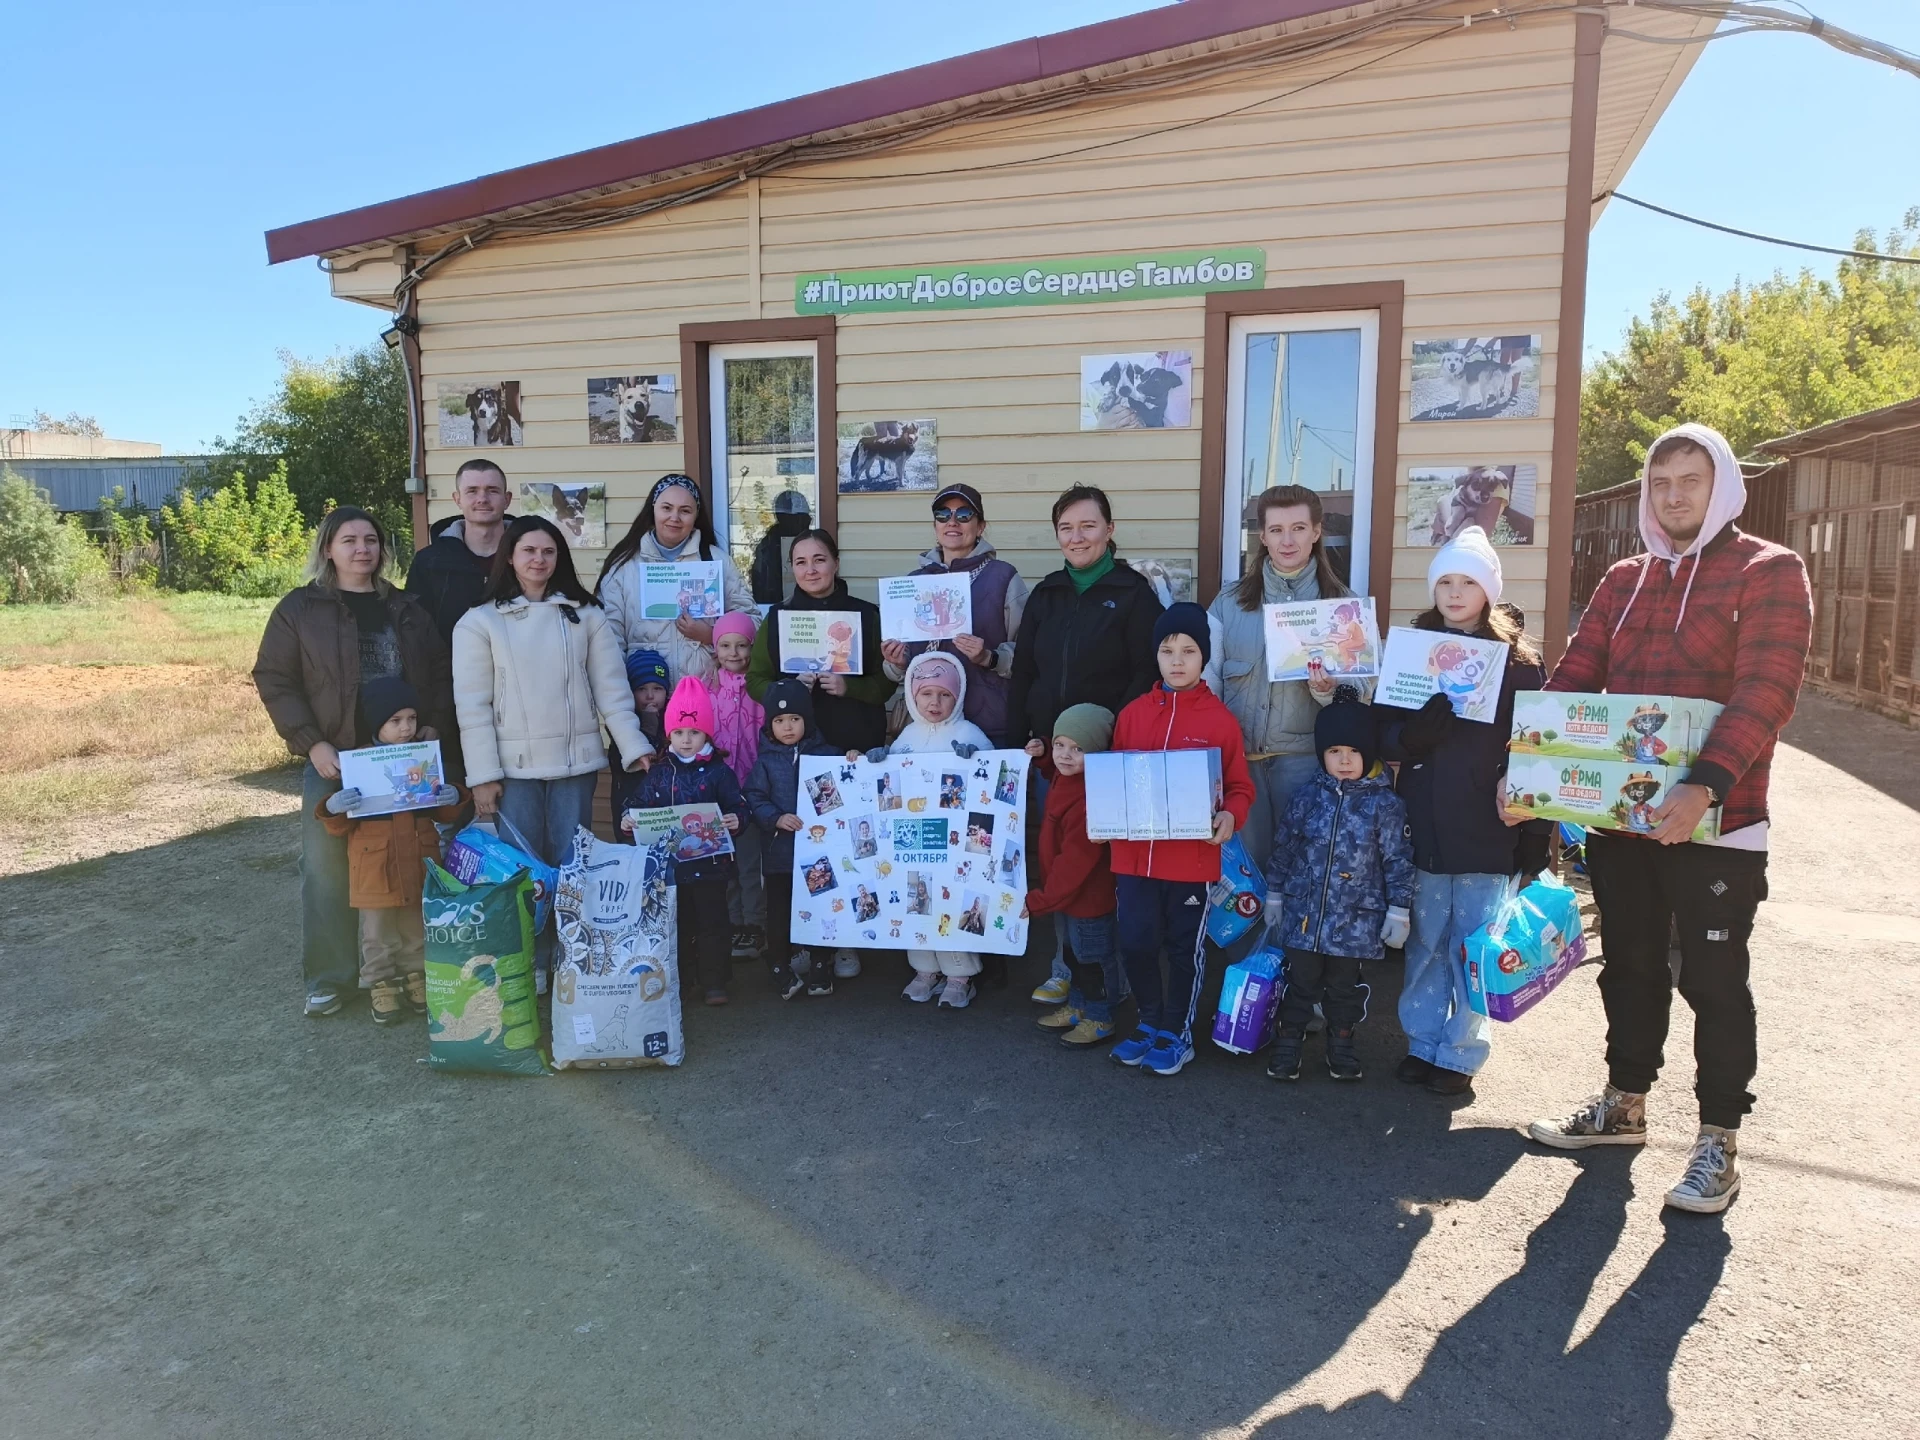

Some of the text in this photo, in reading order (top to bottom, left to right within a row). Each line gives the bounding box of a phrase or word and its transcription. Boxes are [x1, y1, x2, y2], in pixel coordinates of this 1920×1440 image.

[804, 257, 1255, 306] #ПриютДоброеСердцеТамбов
[1275, 606, 1318, 619] ПОМОГАЙ
[1277, 618, 1317, 628] ПТИЦАМ!
[1397, 672, 1434, 683] ПОМОГАЙ
[352, 748, 385, 758] ПОМОГАЙ
[638, 808, 674, 817] ПОМОГАЙ
[894, 853, 948, 863] 4 ОКТЯБРЯ
[424, 924, 488, 944] HOICE
[647, 1040, 660, 1052] 12
